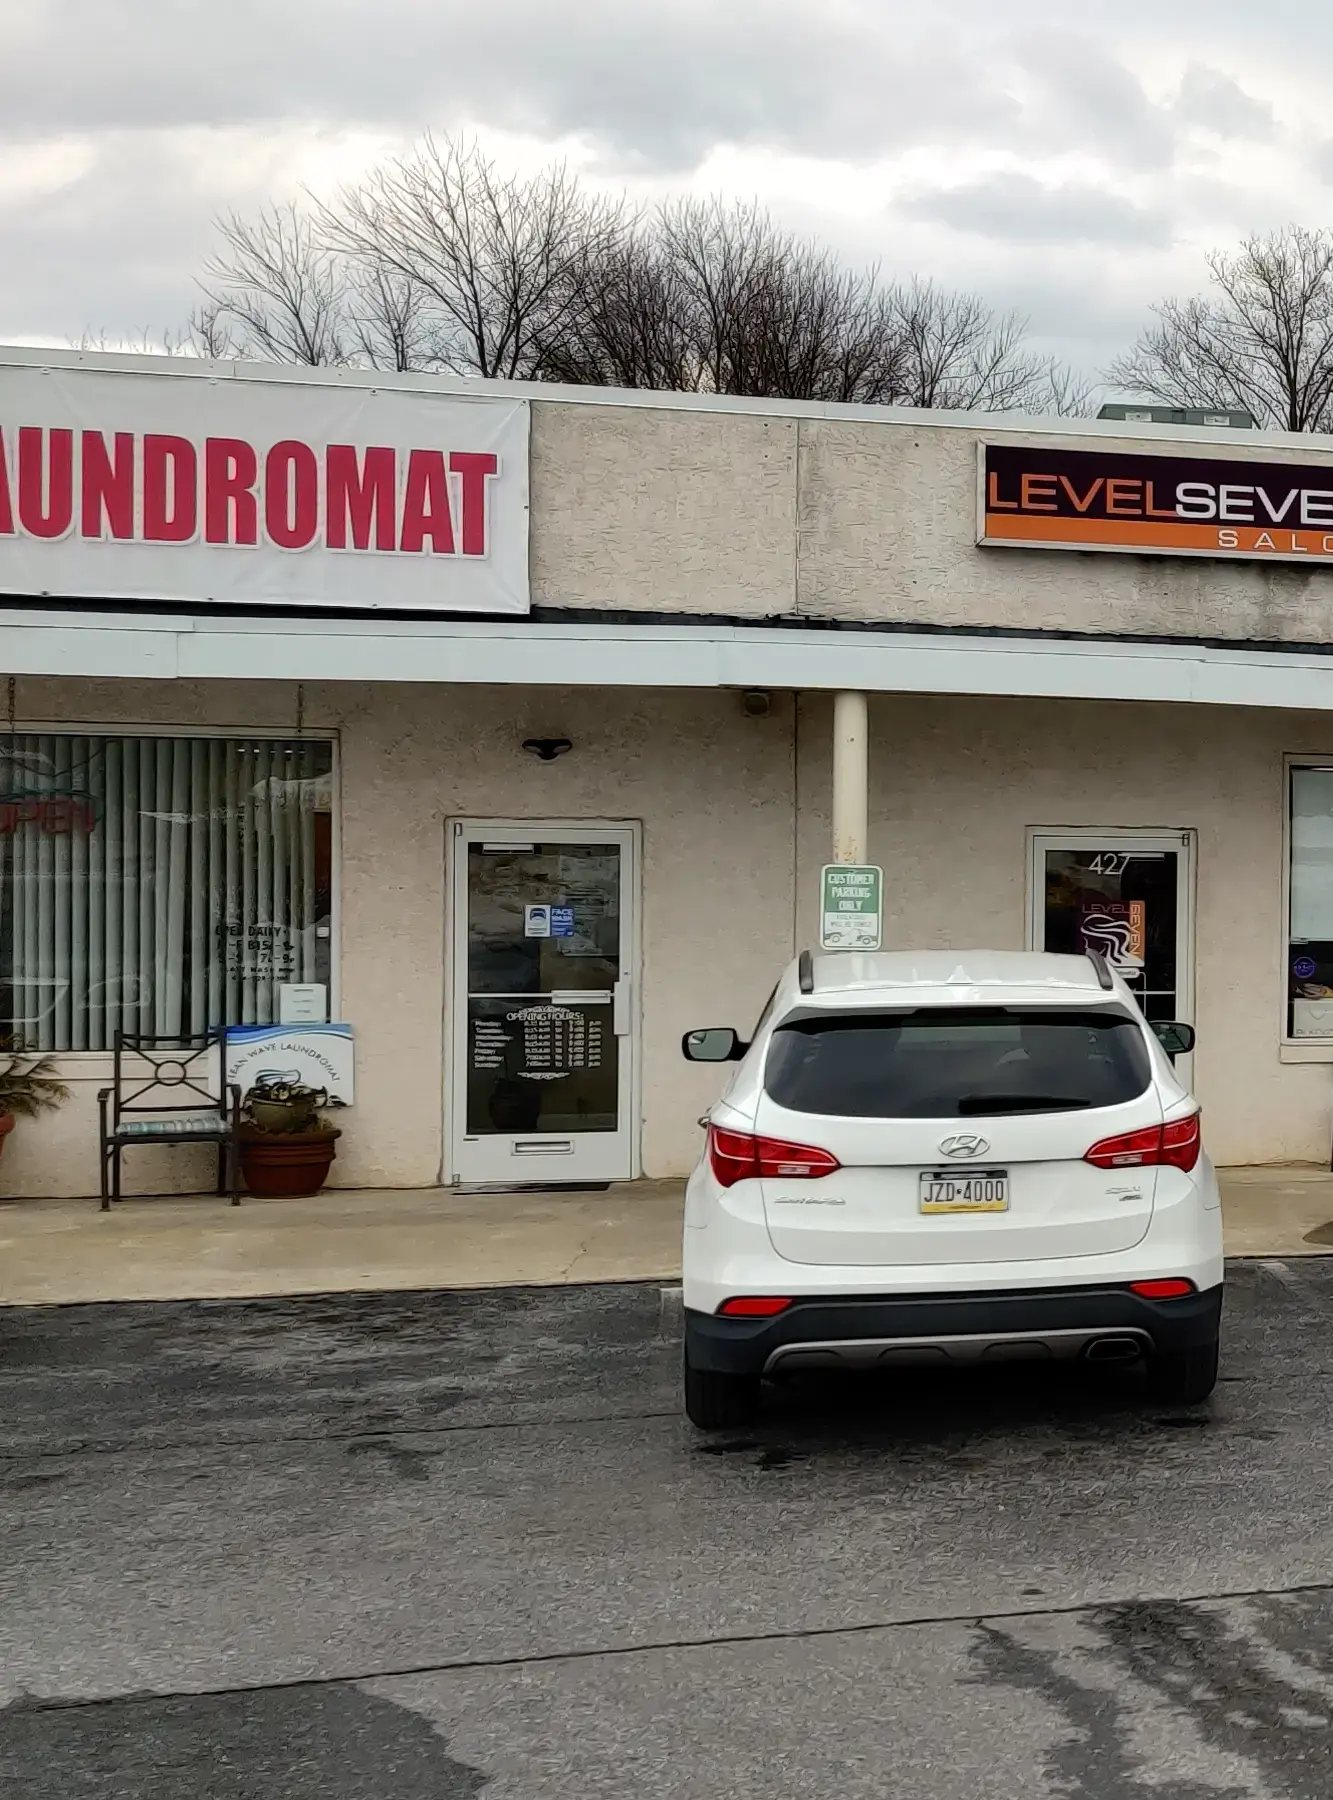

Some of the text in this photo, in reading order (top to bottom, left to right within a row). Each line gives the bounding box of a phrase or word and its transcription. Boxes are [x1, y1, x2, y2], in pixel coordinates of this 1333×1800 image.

[0, 424, 499, 557] UNDROMAT
[1088, 853, 1132, 876] 427
[827, 873, 875, 885] CUSTOMER
[831, 886, 872, 898] PARKING
[1082, 903, 1130, 914] LEVEL
[506, 1011, 547, 1021] OPENING
